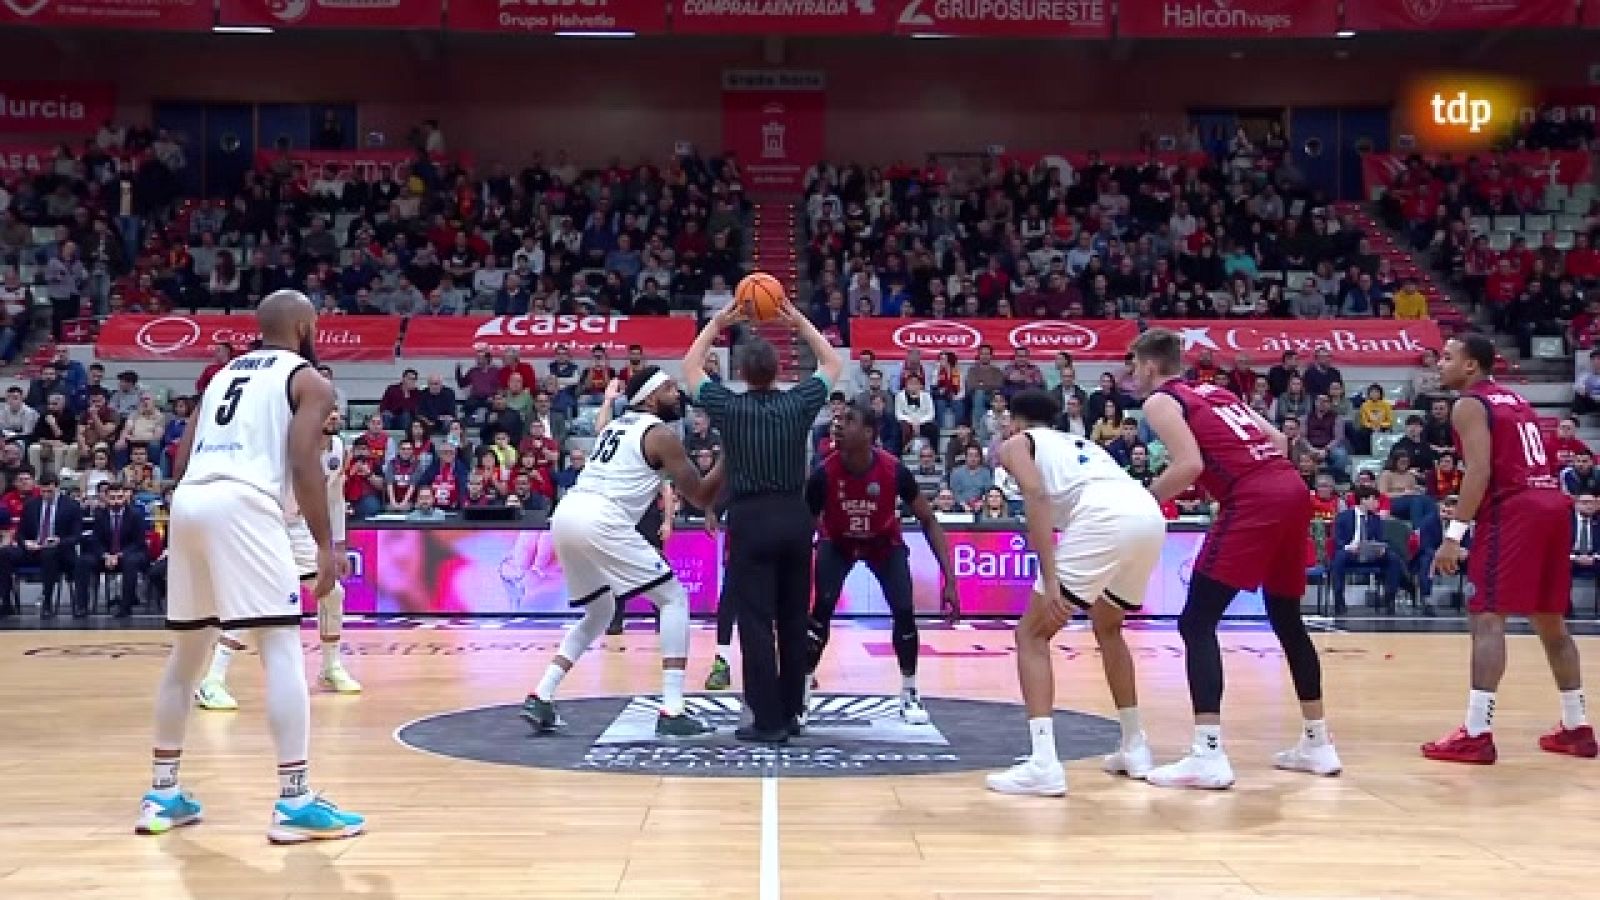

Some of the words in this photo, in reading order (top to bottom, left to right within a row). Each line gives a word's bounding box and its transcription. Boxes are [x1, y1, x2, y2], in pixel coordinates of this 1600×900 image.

[904, 331, 970, 345] Juver
[1020, 331, 1086, 346] Juver
[1226, 328, 1426, 351] CaixaBank
[214, 376, 252, 426] 5
[1517, 421, 1547, 466] 10
[849, 516, 871, 531] 21
